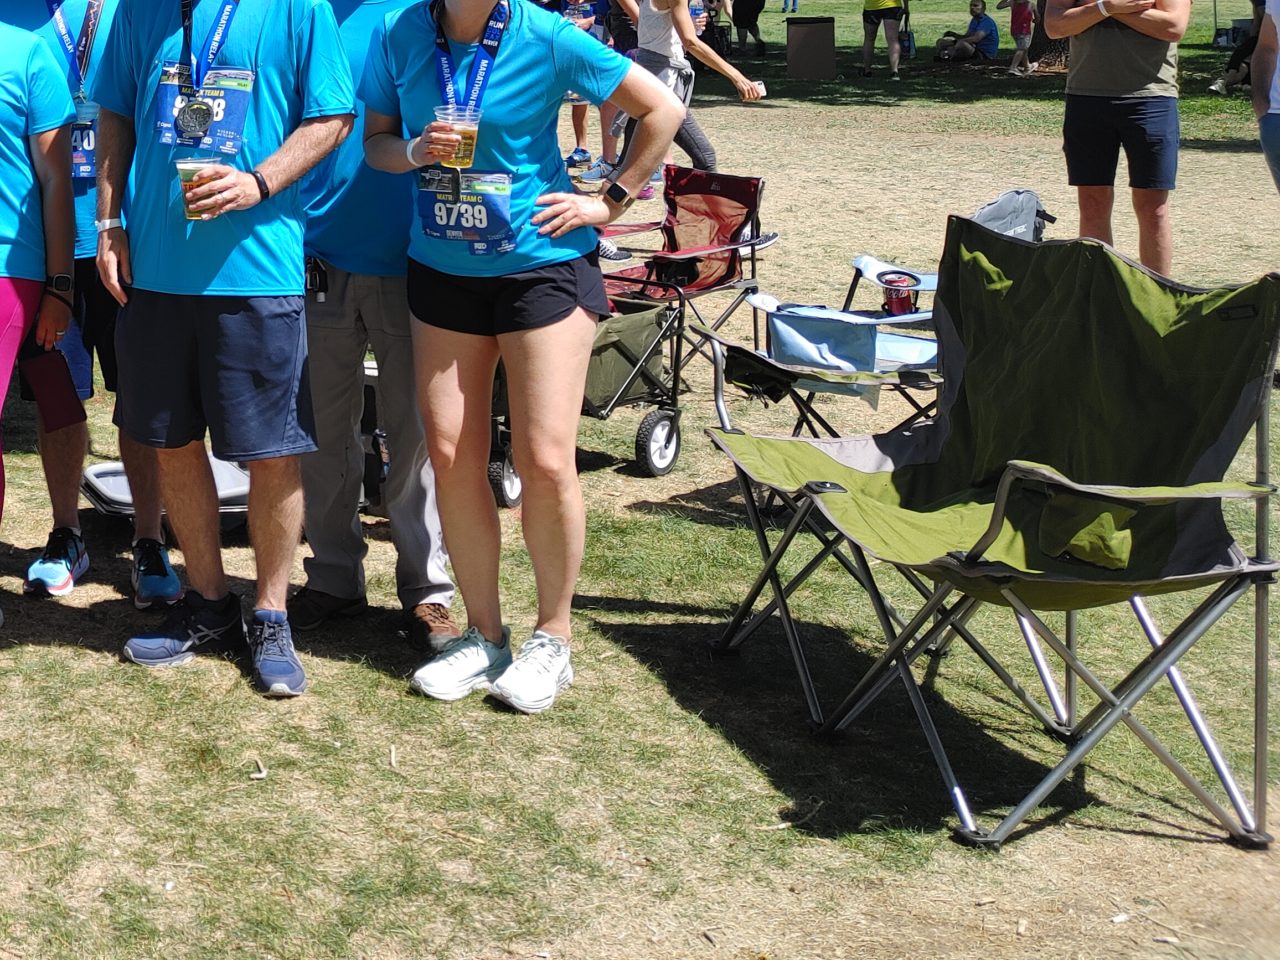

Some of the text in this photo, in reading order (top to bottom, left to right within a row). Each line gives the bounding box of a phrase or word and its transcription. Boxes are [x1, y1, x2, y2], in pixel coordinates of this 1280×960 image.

[207, 4, 232, 63] MARATHON RELAY
[488, 20, 505, 30] RUN
[62, 33, 75, 53] RELAY
[482, 39, 498, 47] DENVER
[440, 56, 455, 100] MARATHON
[469, 59, 489, 102] MARATHON
[173, 95, 226, 122] 98
[71, 130, 95, 150] 40
[460, 194, 477, 202] TEAM
[477, 195, 483, 203] C
[434, 202, 488, 229] 9739
